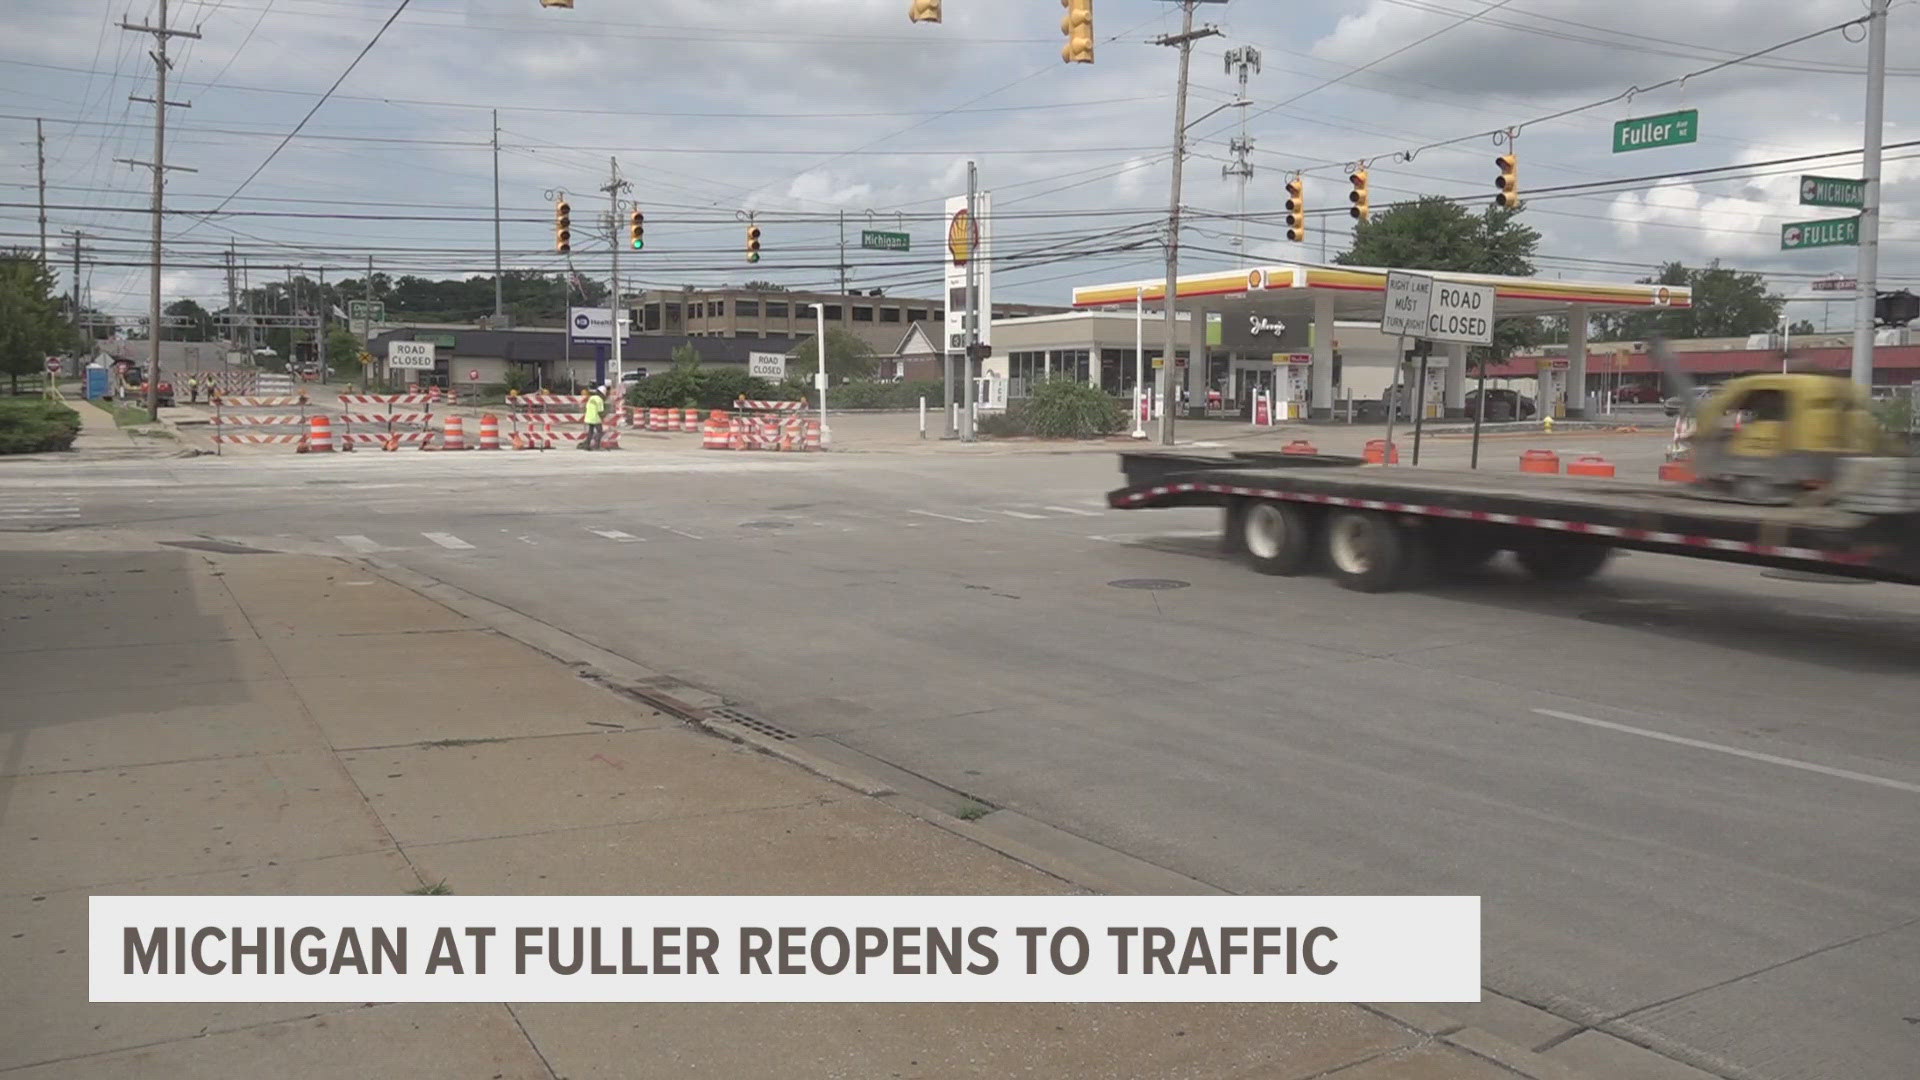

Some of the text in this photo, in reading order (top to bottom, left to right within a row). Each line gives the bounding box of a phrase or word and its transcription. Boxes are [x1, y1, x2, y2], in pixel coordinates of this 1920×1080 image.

[1621, 123, 1672, 145] Fuller
[1816, 182, 1863, 203] MICHIGAN
[1803, 223, 1855, 244] FULLER
[864, 234, 902, 249] Michigan
[1390, 280, 1429, 293] RIGHT LANE
[1395, 297, 1417, 311] MUST
[1440, 289, 1481, 309] ROAD
[1386, 316, 1425, 330] TURN RIGHT
[1429, 314, 1486, 336] CLOSED
[397, 345, 425, 354] ROAD
[392, 356, 431, 366] CLOSED
[758, 356, 778, 364] ROAD
[753, 365, 781, 374] CLOSED
